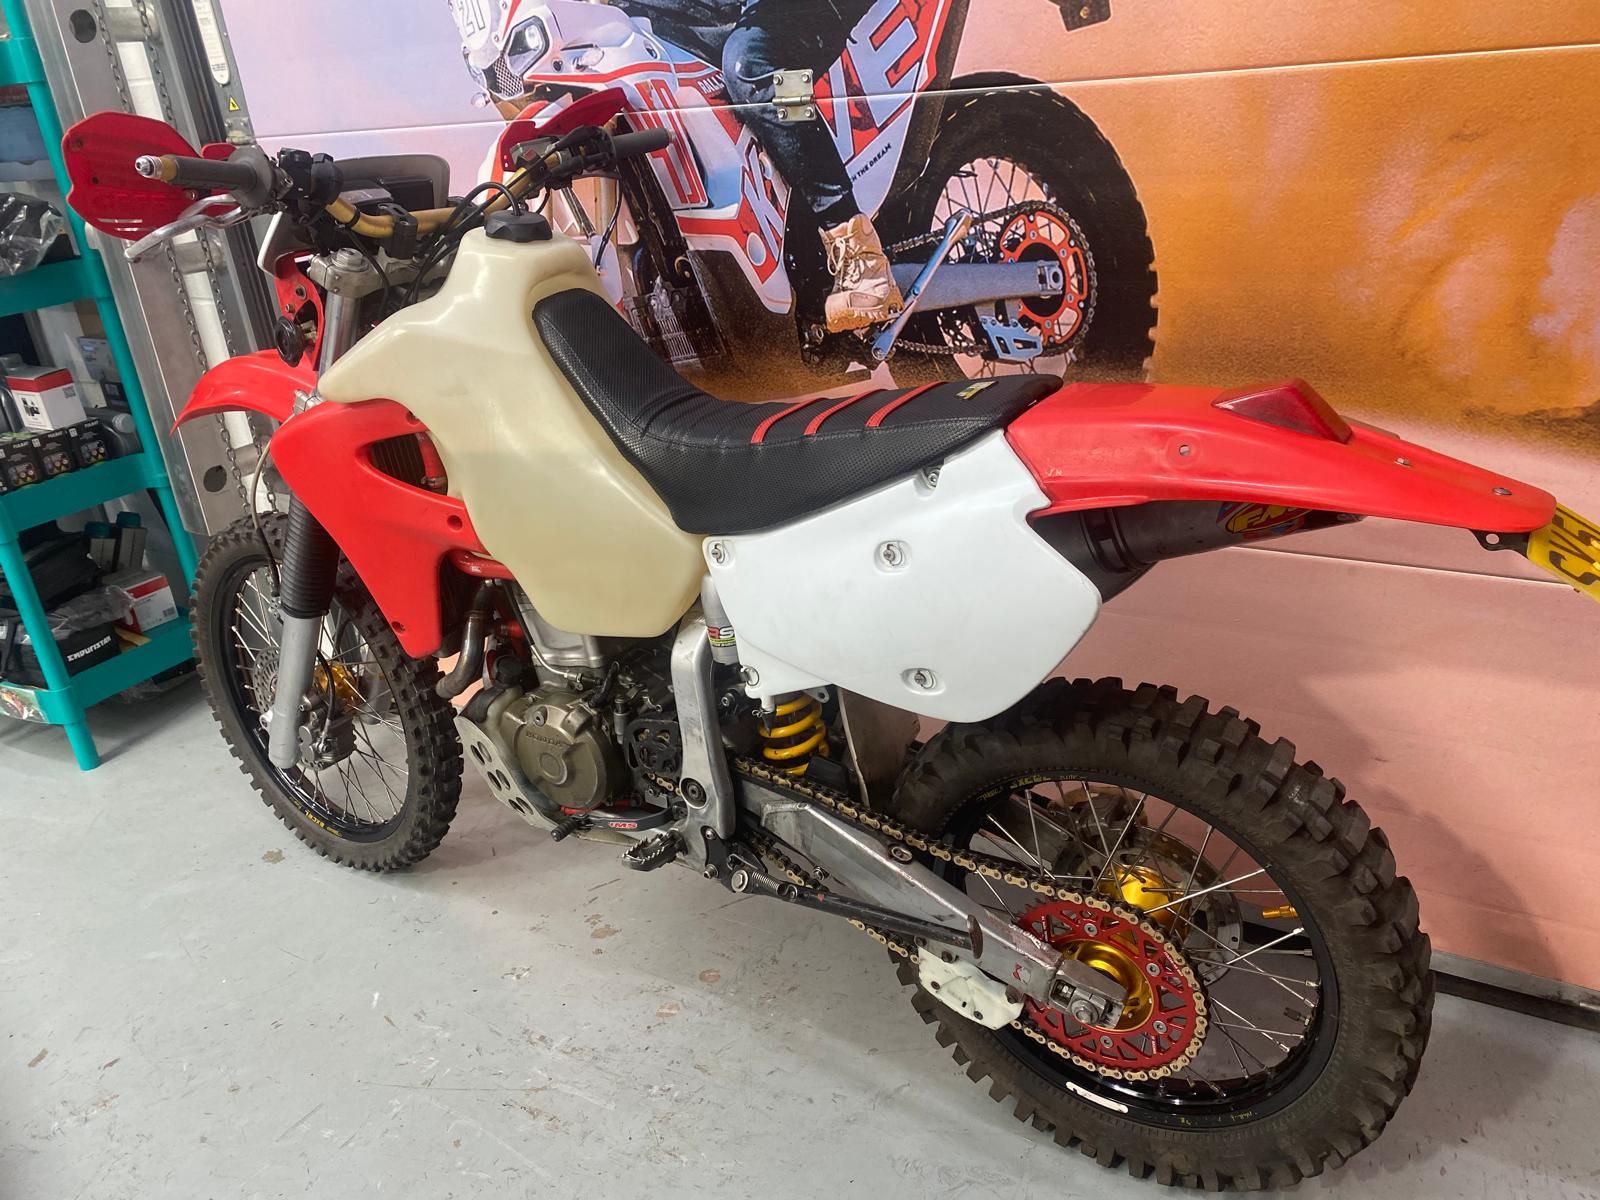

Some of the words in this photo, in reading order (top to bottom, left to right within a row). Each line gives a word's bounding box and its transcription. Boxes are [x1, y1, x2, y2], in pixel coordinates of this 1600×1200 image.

[856, 164, 869, 177] THE
[868, 142, 892, 167] DREAM
[66, 635, 112, 662] ENDURISTAN
